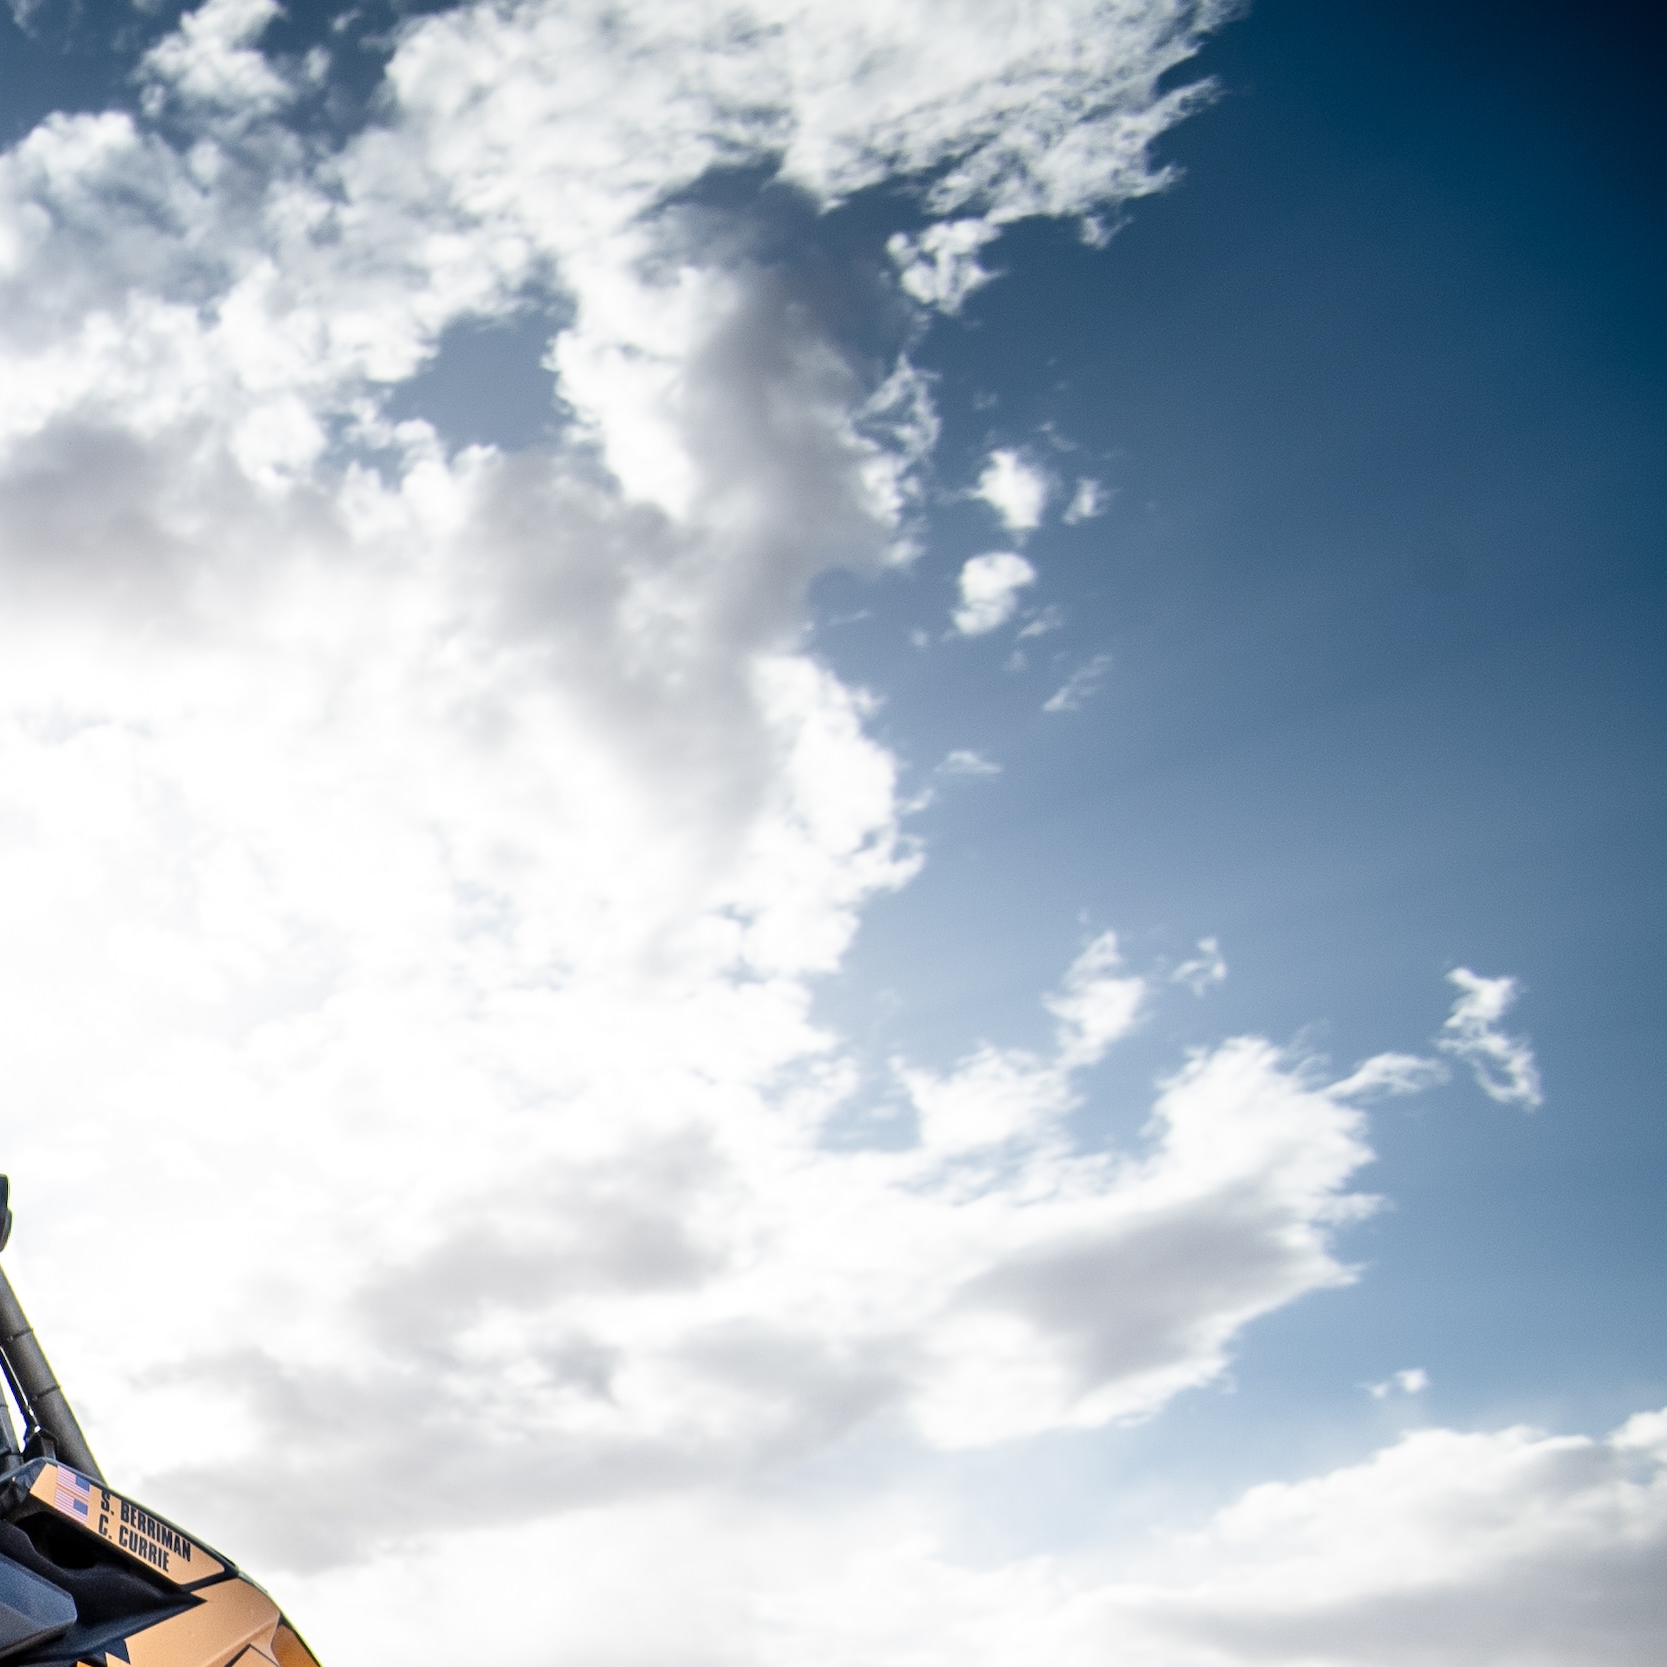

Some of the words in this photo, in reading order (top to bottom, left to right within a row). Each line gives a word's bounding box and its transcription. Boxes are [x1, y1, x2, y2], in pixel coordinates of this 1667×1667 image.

[98, 1513, 113, 1540] C.
[118, 1524, 170, 1572] CURRIE
[120, 1499, 191, 1562] BERRIMAN
